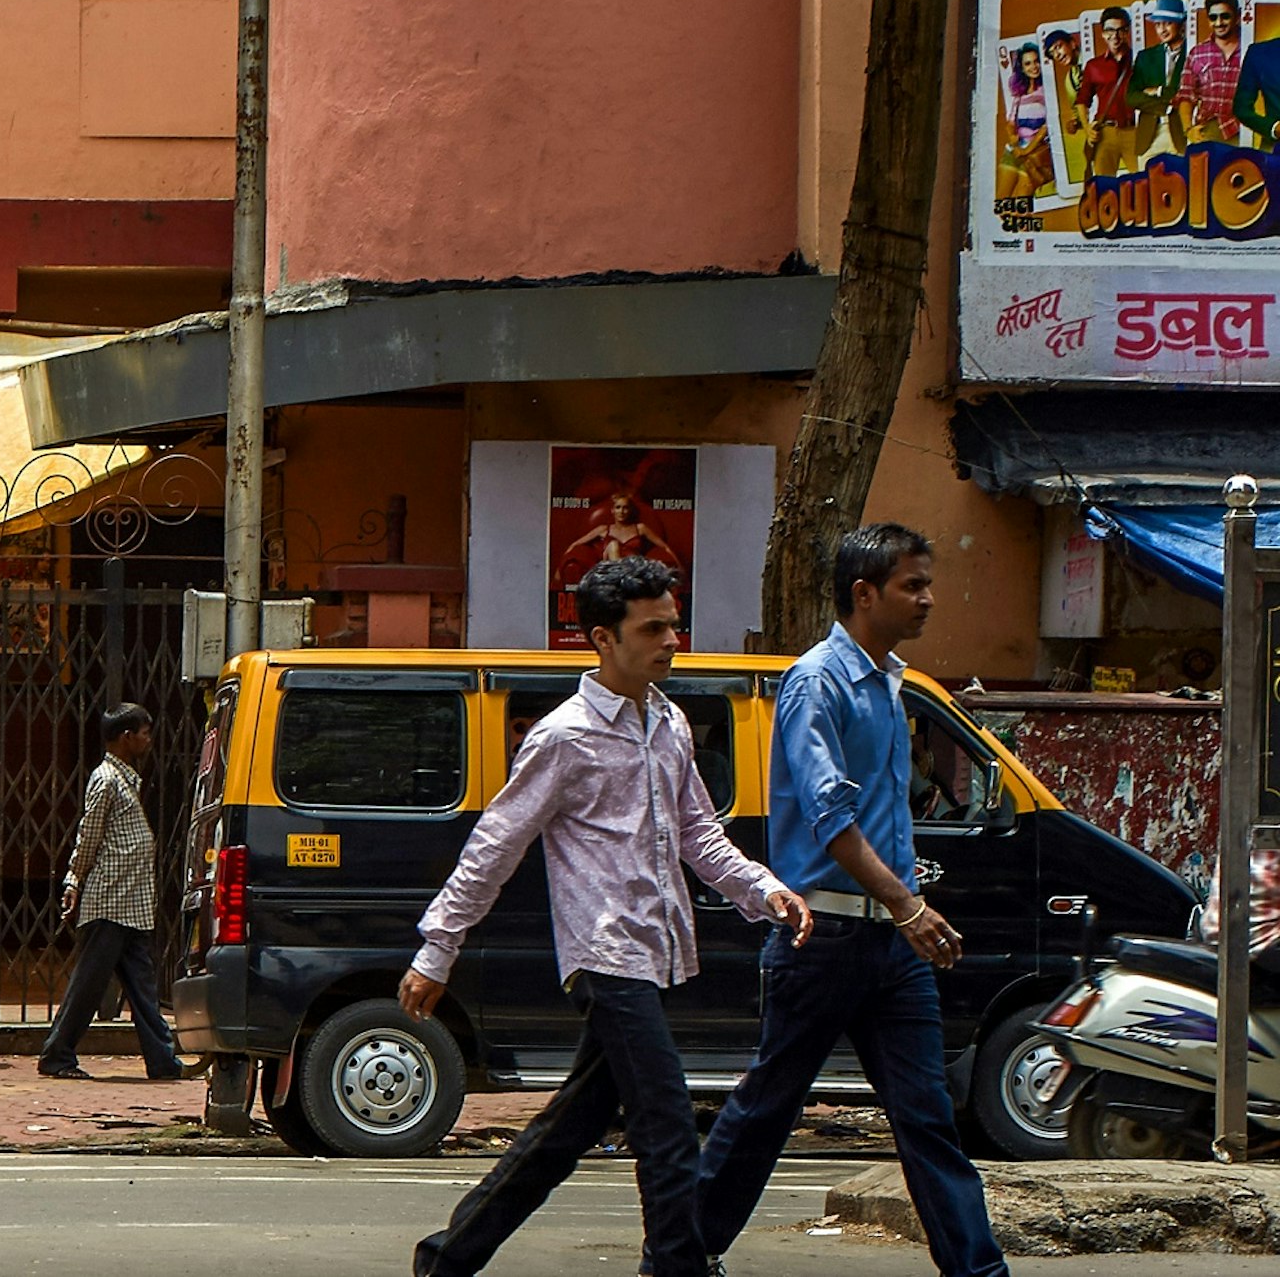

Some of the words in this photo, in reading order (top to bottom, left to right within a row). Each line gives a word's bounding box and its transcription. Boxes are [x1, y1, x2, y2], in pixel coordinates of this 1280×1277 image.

[1079, 150, 1270, 234] double
[995, 289, 1064, 337] संजय
[1044, 315, 1097, 358] दत्त
[1115, 293, 1276, 360] डबल
[1103, 1027, 1180, 1047] Activa
